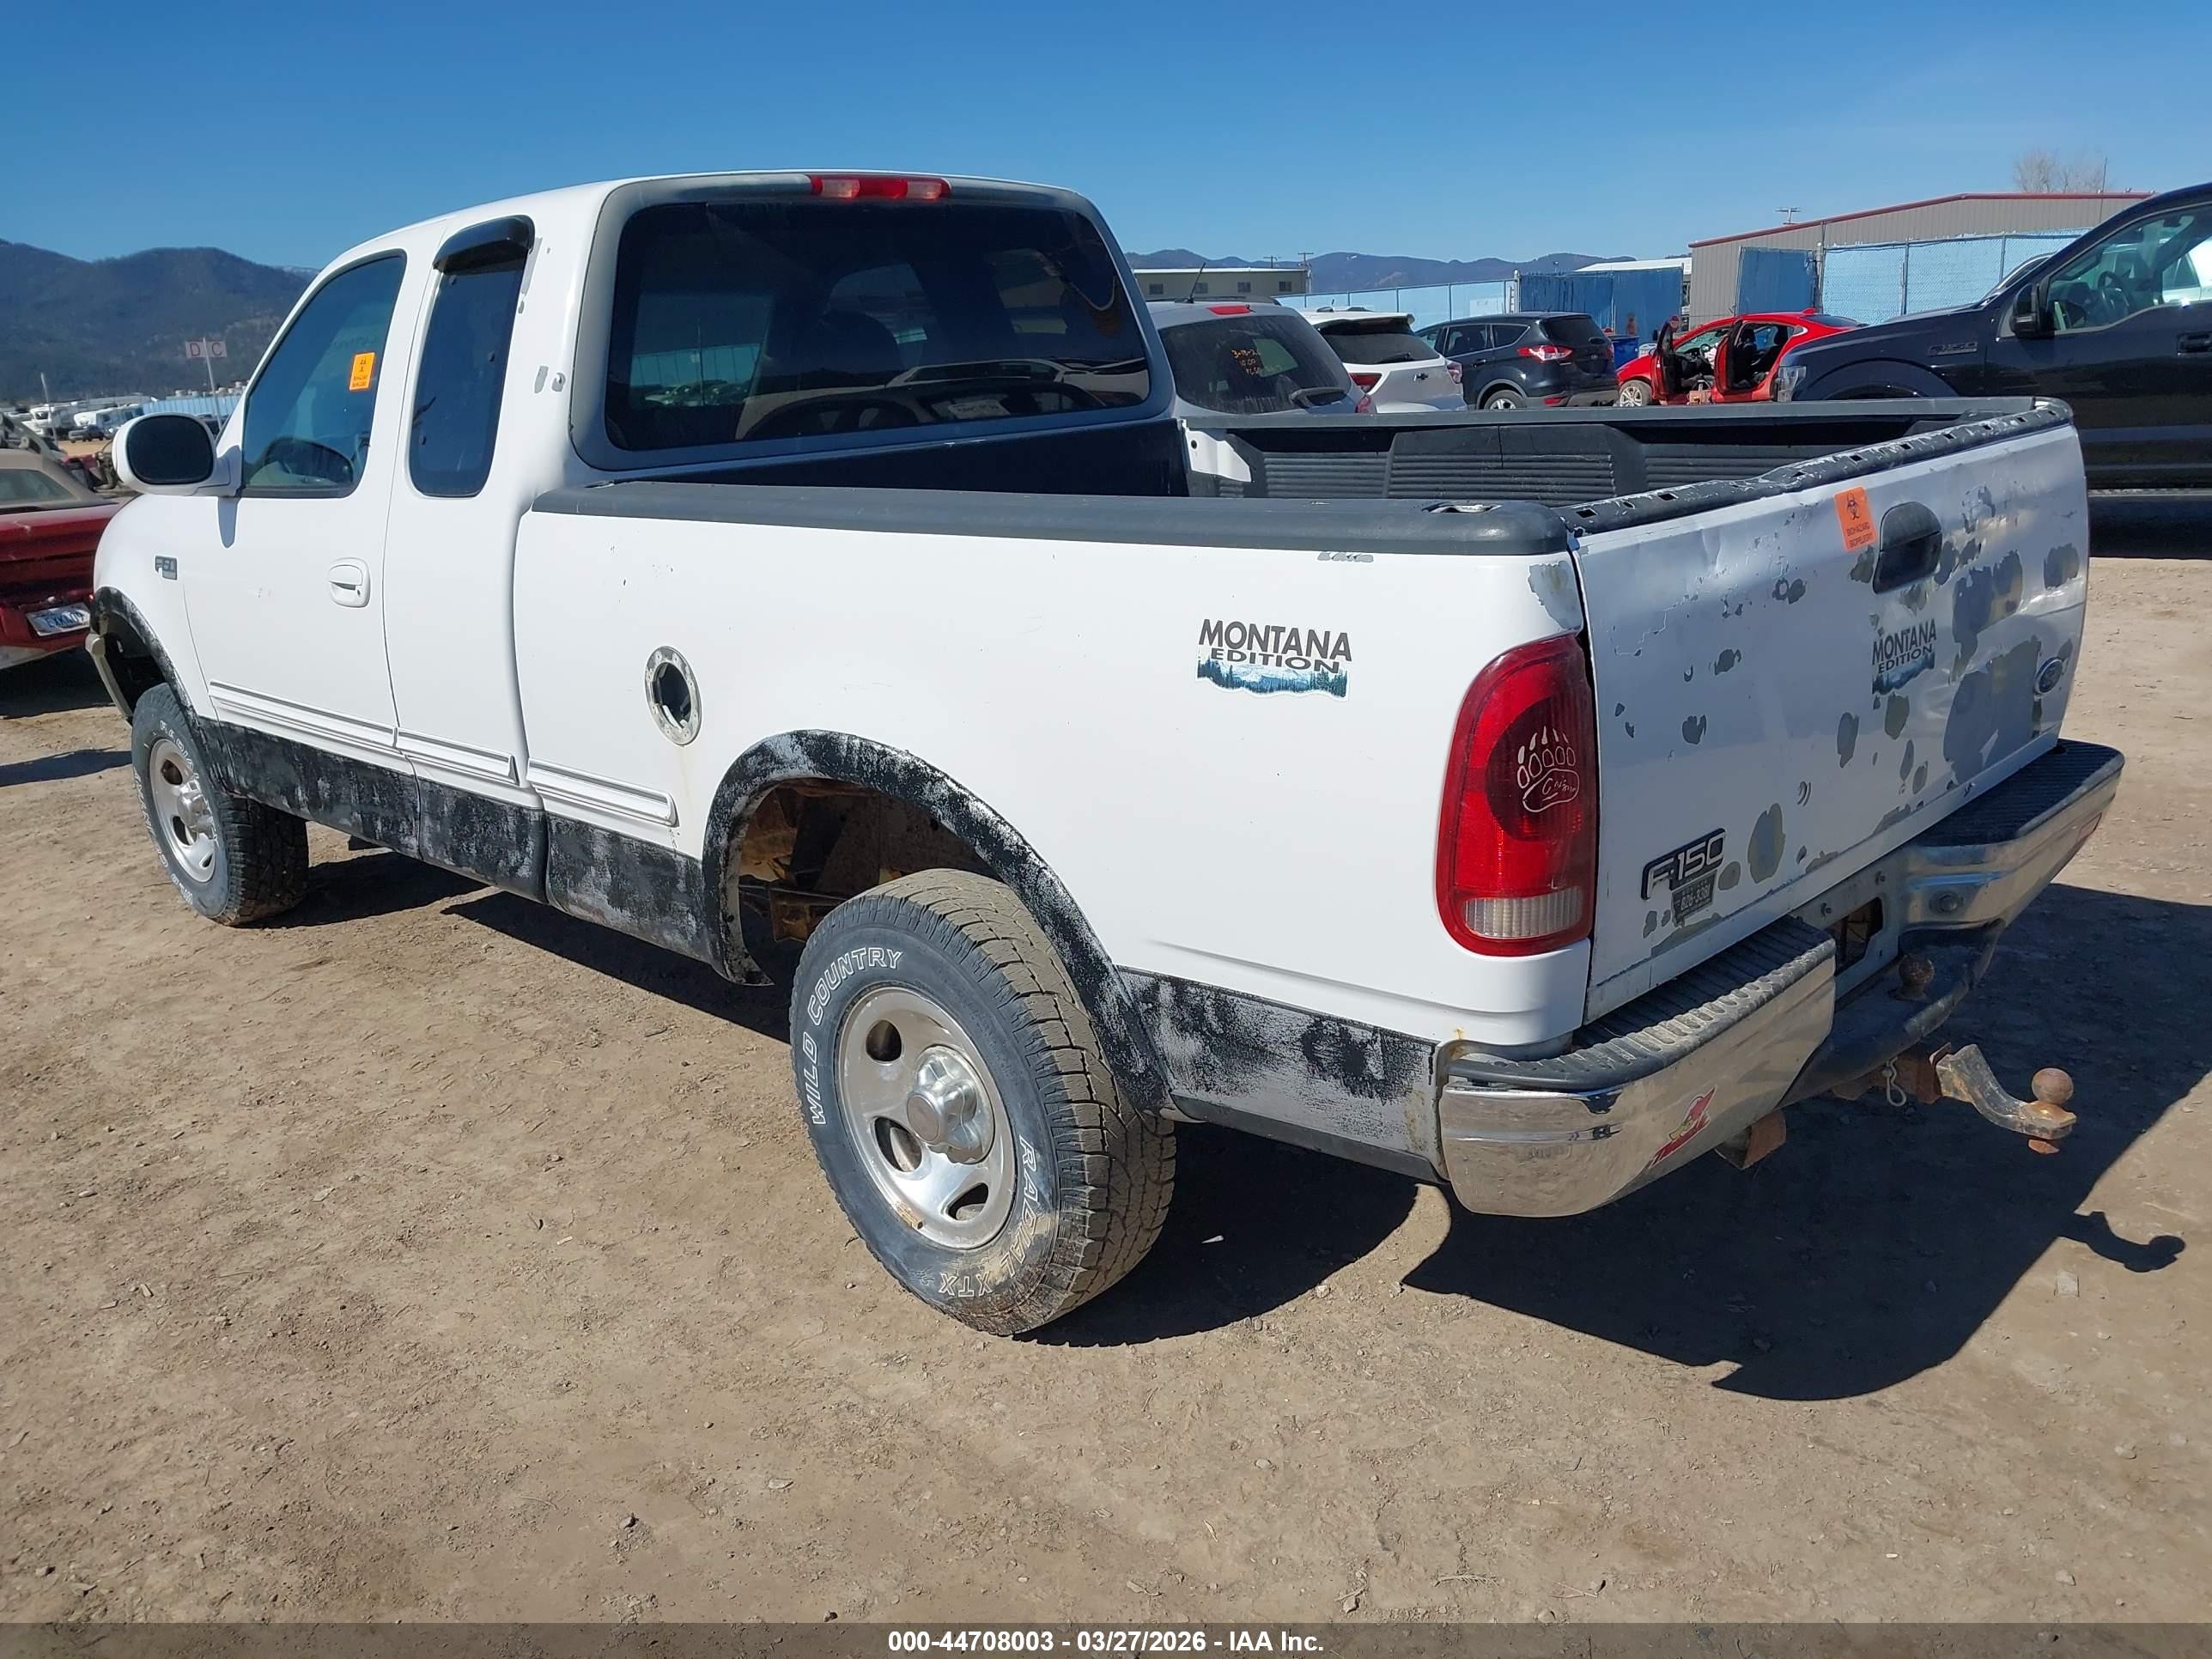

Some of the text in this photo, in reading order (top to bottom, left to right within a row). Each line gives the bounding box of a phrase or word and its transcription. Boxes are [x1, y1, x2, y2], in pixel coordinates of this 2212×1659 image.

[189, 342, 223, 357] D C
[1198, 618, 1352, 662] MONTANA
[1211, 647, 1340, 674] EDITION
[1872, 618, 1937, 665] MONTANA
[1878, 643, 1932, 674] EDITION
[803, 947, 902, 1125] WILD COUNTRY
[938, 1134, 1039, 1297] RADIAL XTX
